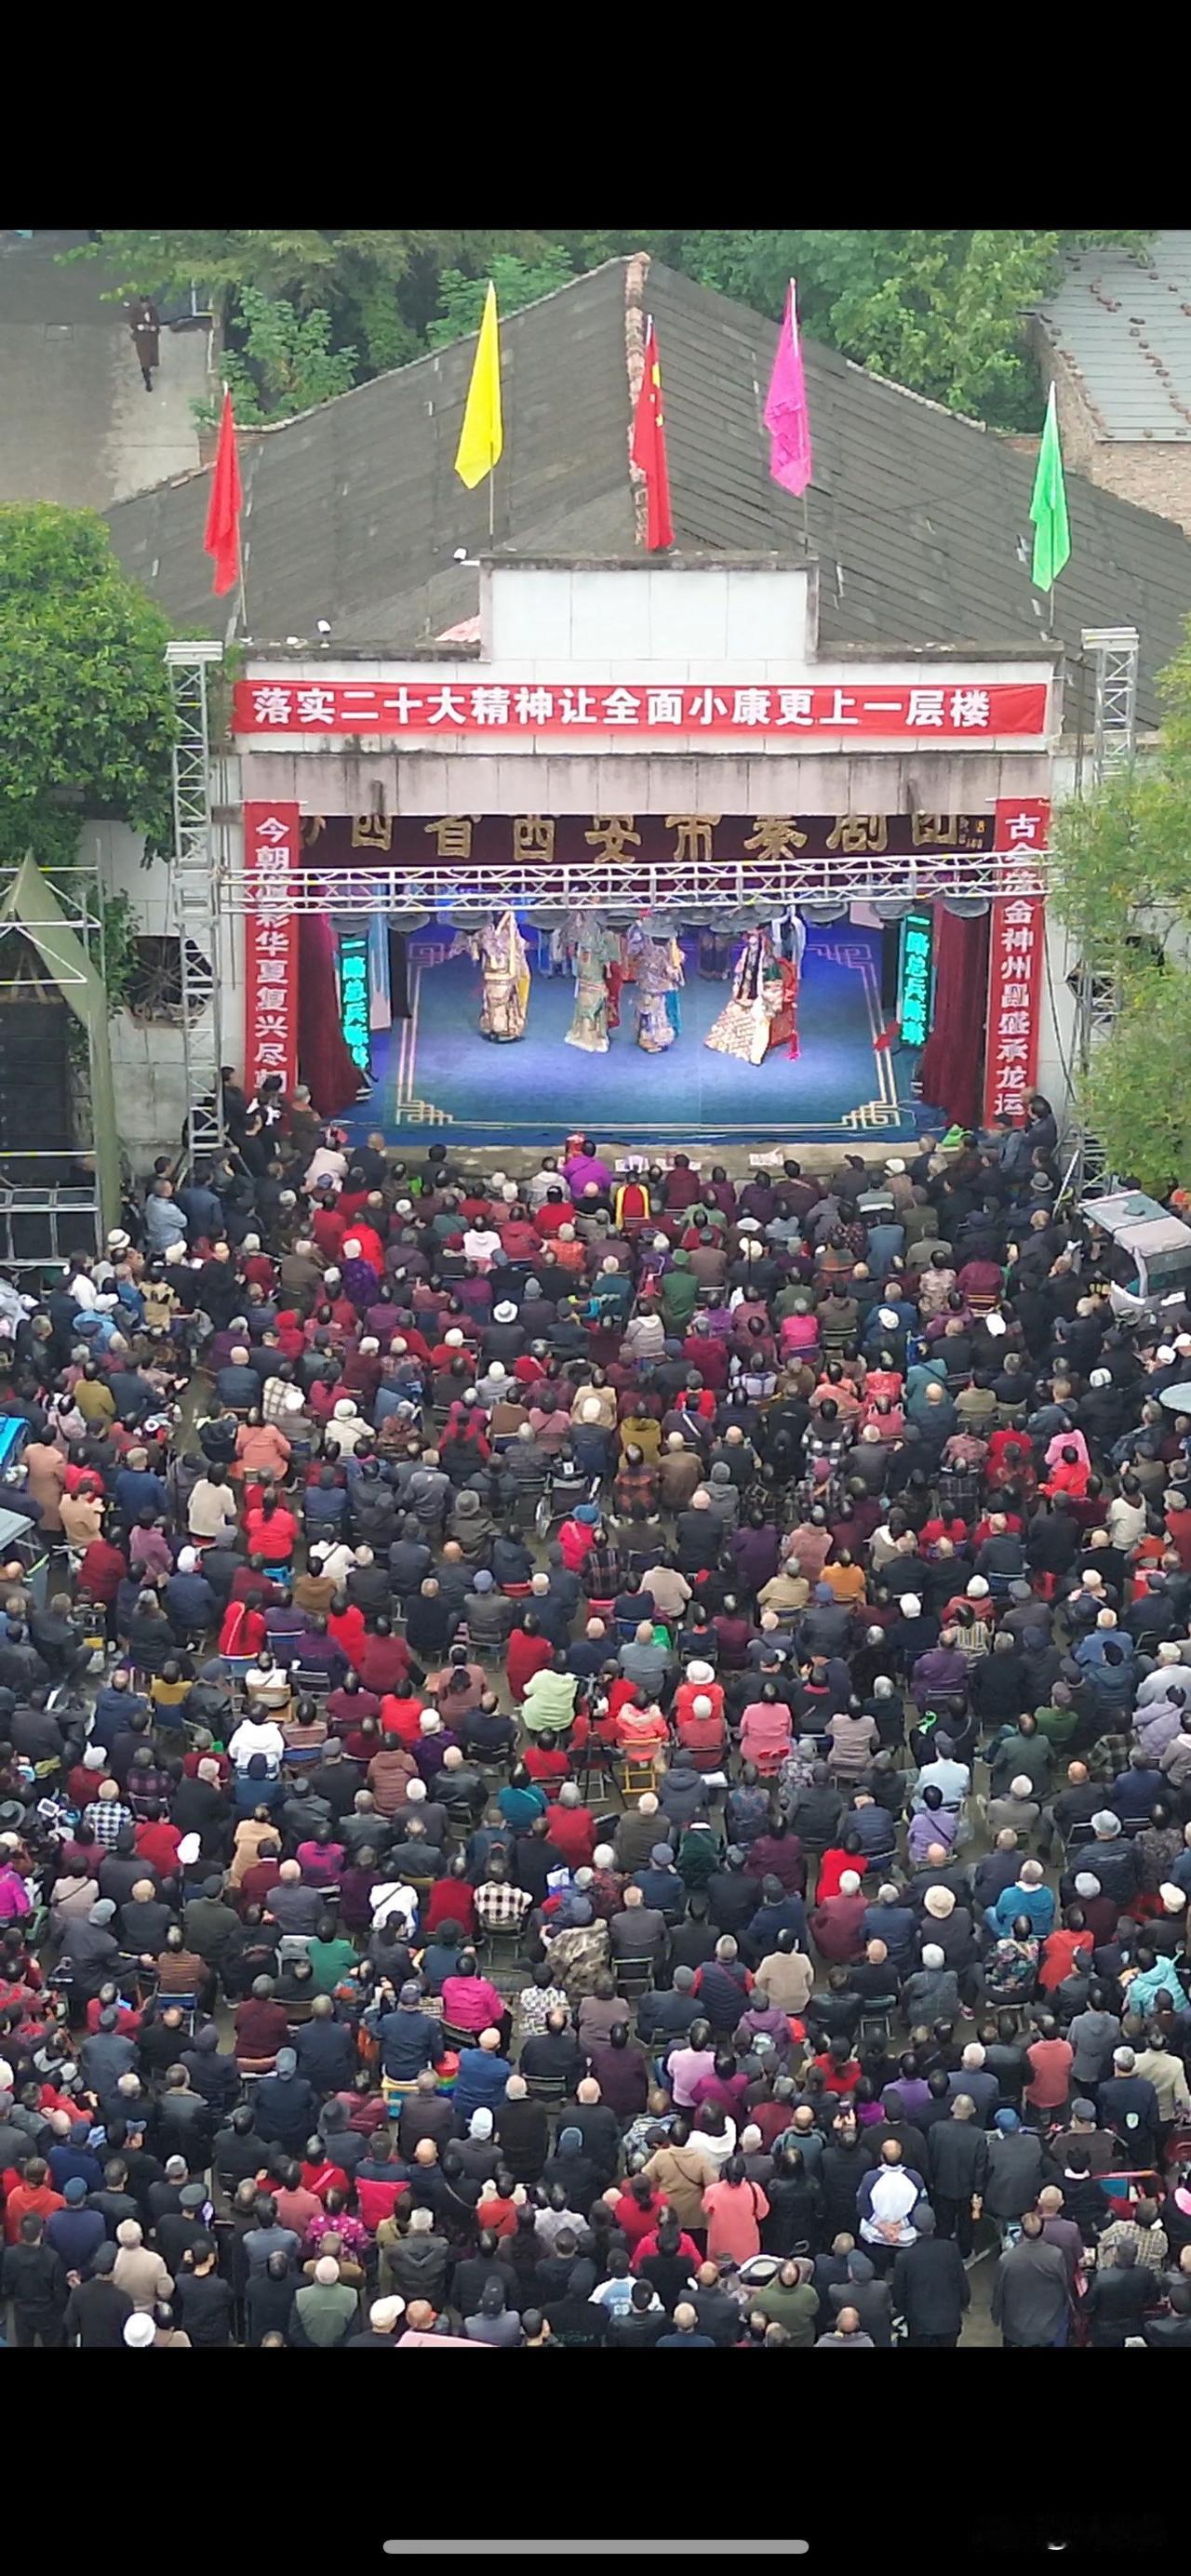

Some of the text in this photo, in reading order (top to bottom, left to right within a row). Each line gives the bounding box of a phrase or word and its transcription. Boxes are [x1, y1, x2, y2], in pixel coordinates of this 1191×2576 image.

[252, 687, 990, 728] 落实二十大精神让全面小康更上一层楼
